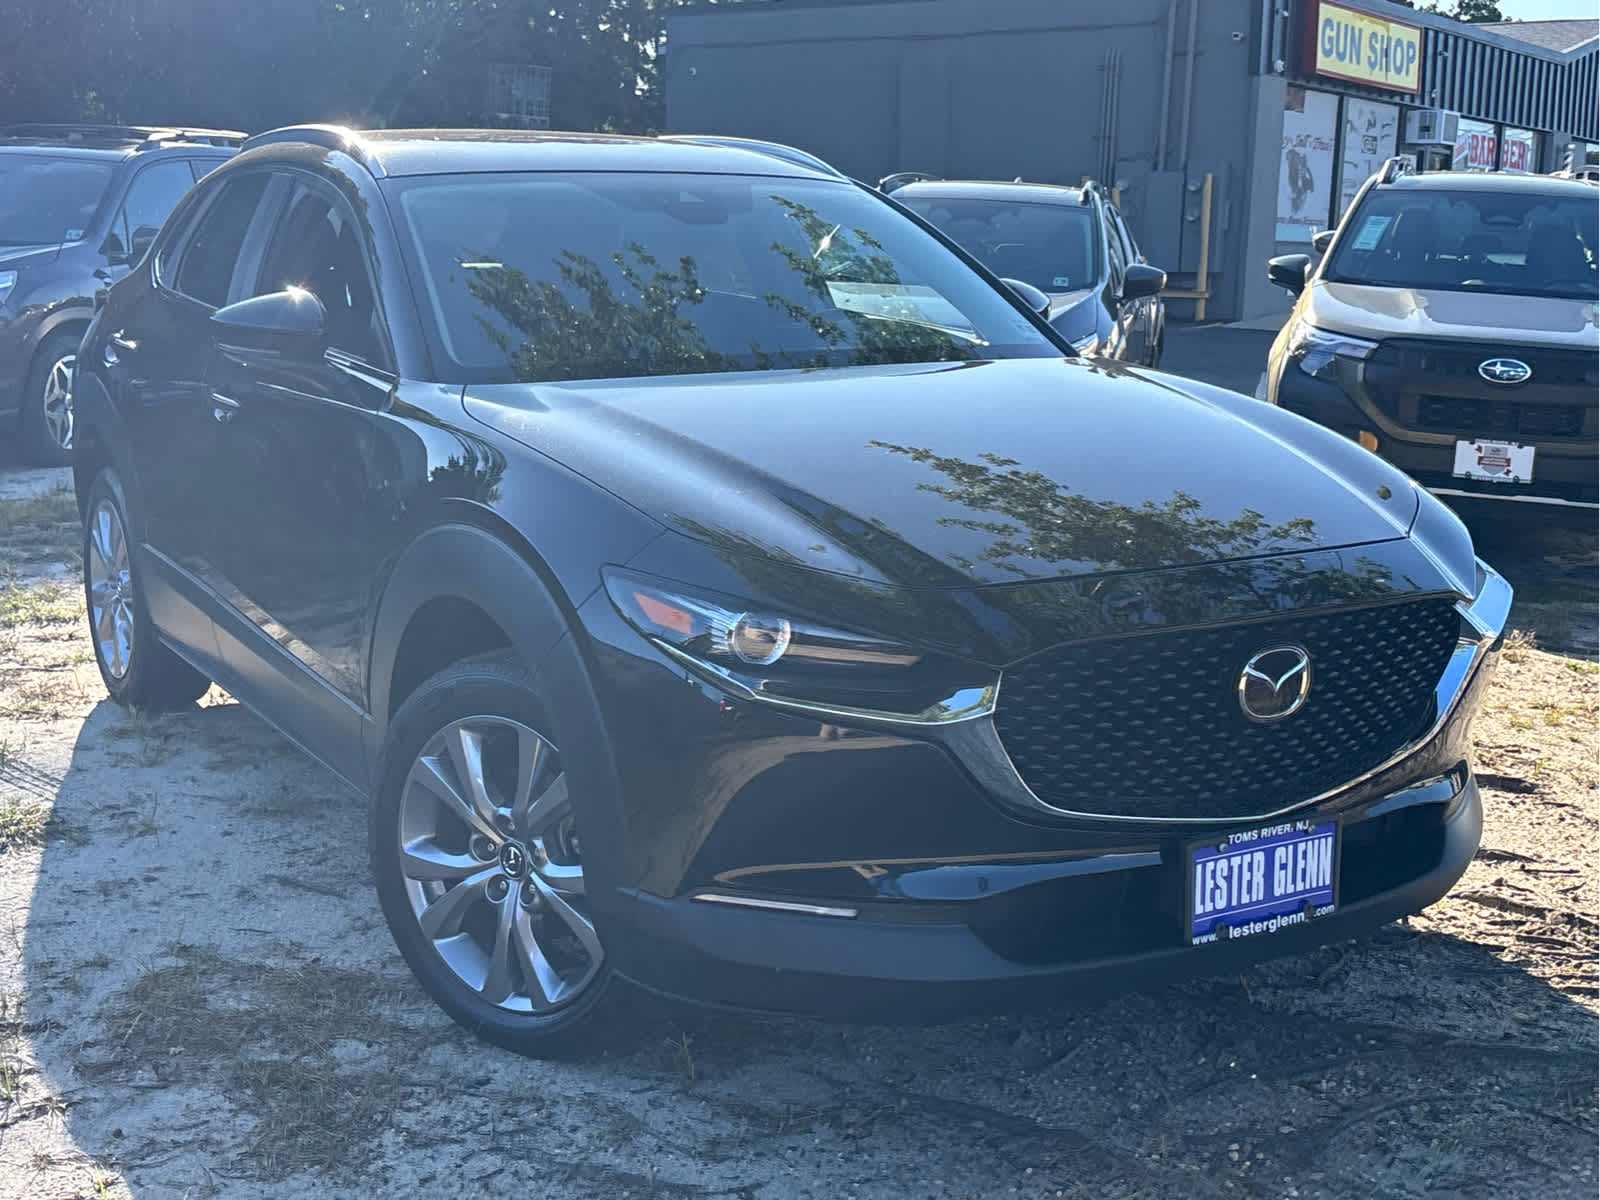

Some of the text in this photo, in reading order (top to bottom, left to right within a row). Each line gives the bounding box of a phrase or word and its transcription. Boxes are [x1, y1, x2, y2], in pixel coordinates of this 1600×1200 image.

[1321, 17, 1416, 76] GUN SHOP
[1469, 134, 1526, 169] BARBER
[1228, 830, 1258, 845] TOMS
[1195, 836, 1333, 915] LESTER GLENN
